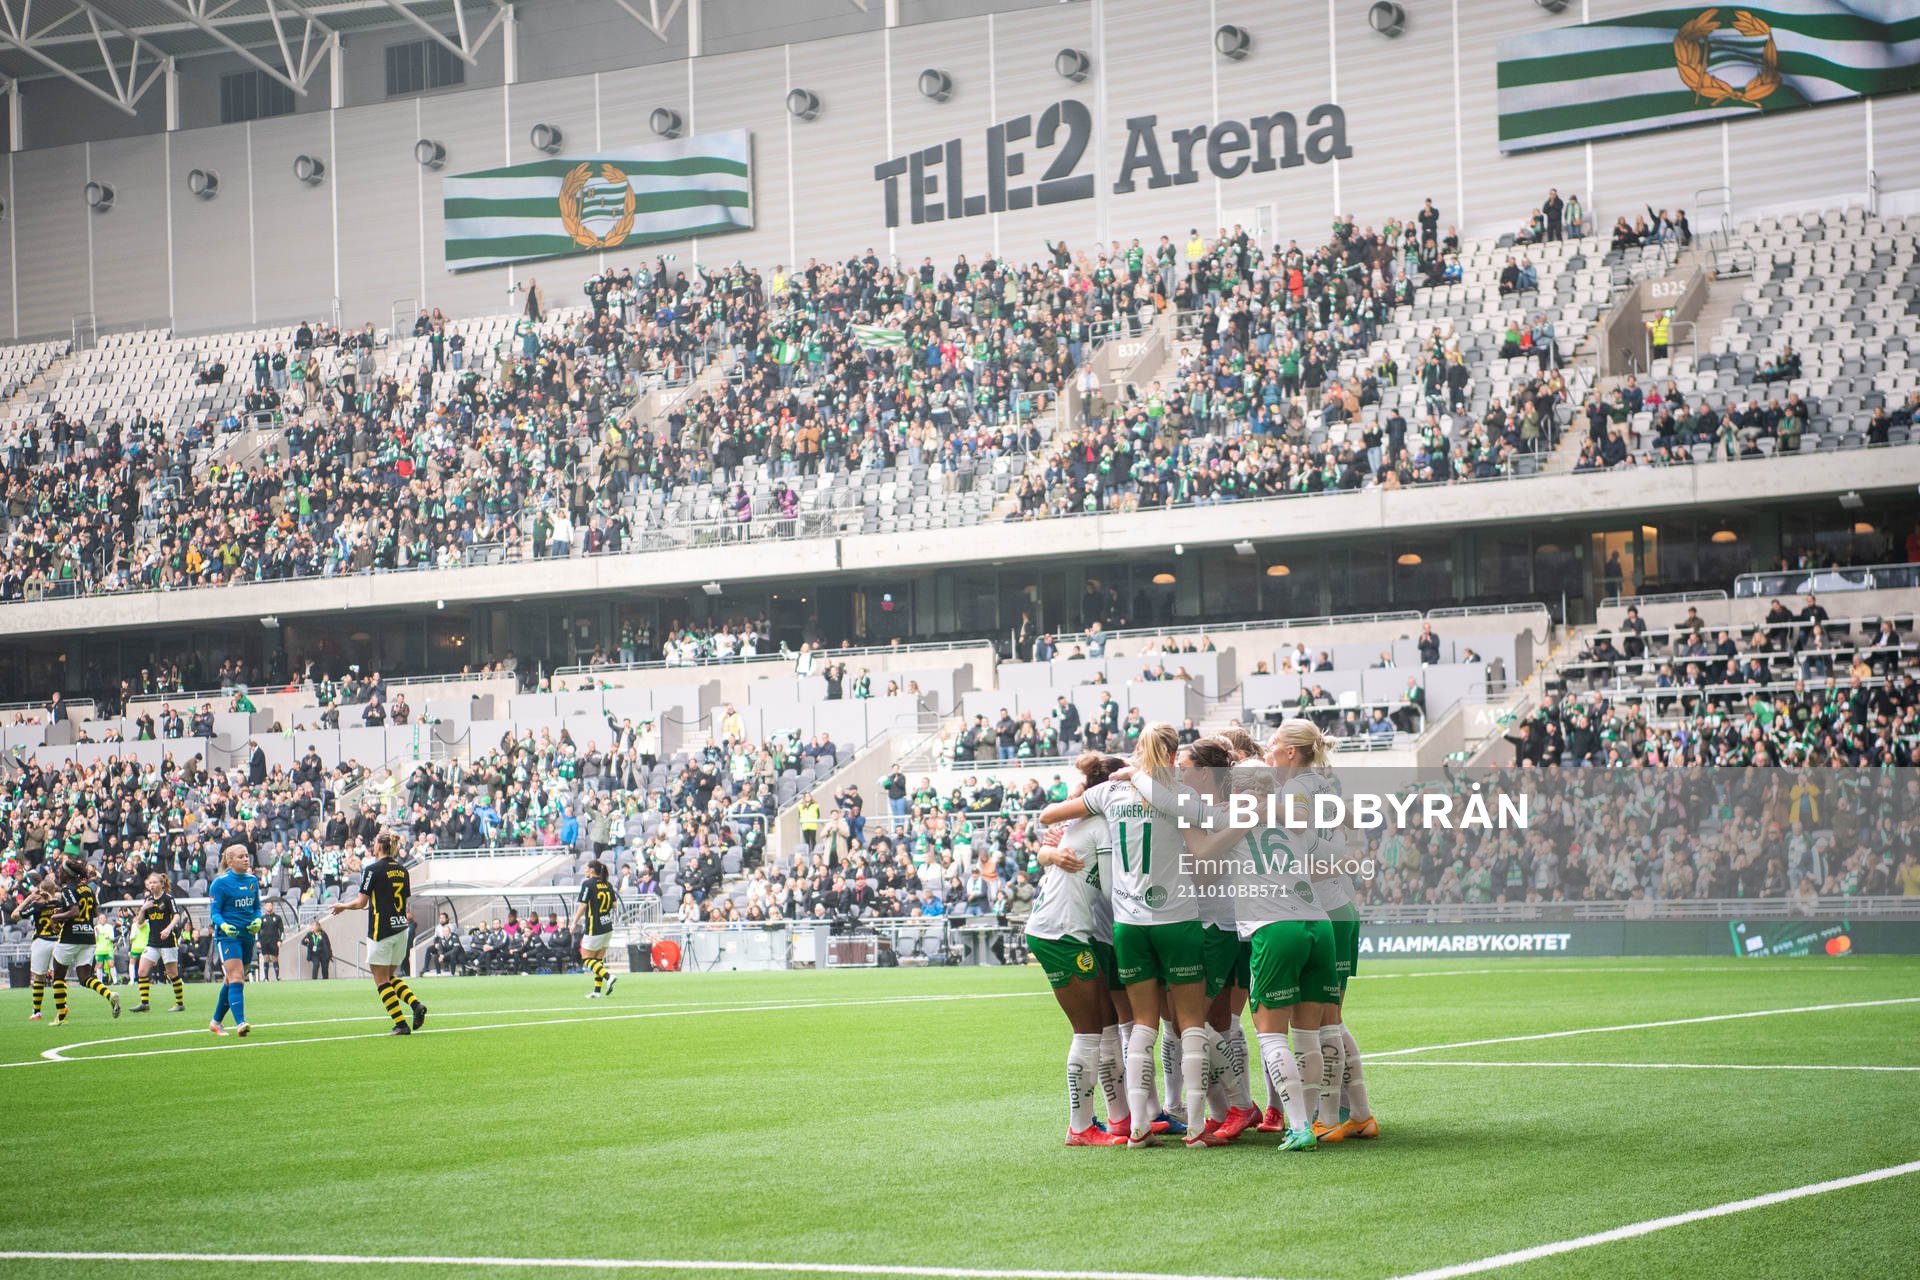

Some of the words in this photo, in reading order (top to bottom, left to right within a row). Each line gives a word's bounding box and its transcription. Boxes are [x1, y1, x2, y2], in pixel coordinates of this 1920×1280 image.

[874, 99, 1094, 228] TELE2
[1113, 103, 1353, 195] Arena
[1652, 280, 1687, 297] B325
[1118, 822, 1152, 875] 11
[1245, 828, 1295, 876] 16
[392, 882, 404, 912] 3
[597, 891, 611, 913] 21
[72, 924, 94, 932] SVEA
[1378, 933, 1571, 953] HAMMARBYKORTET
